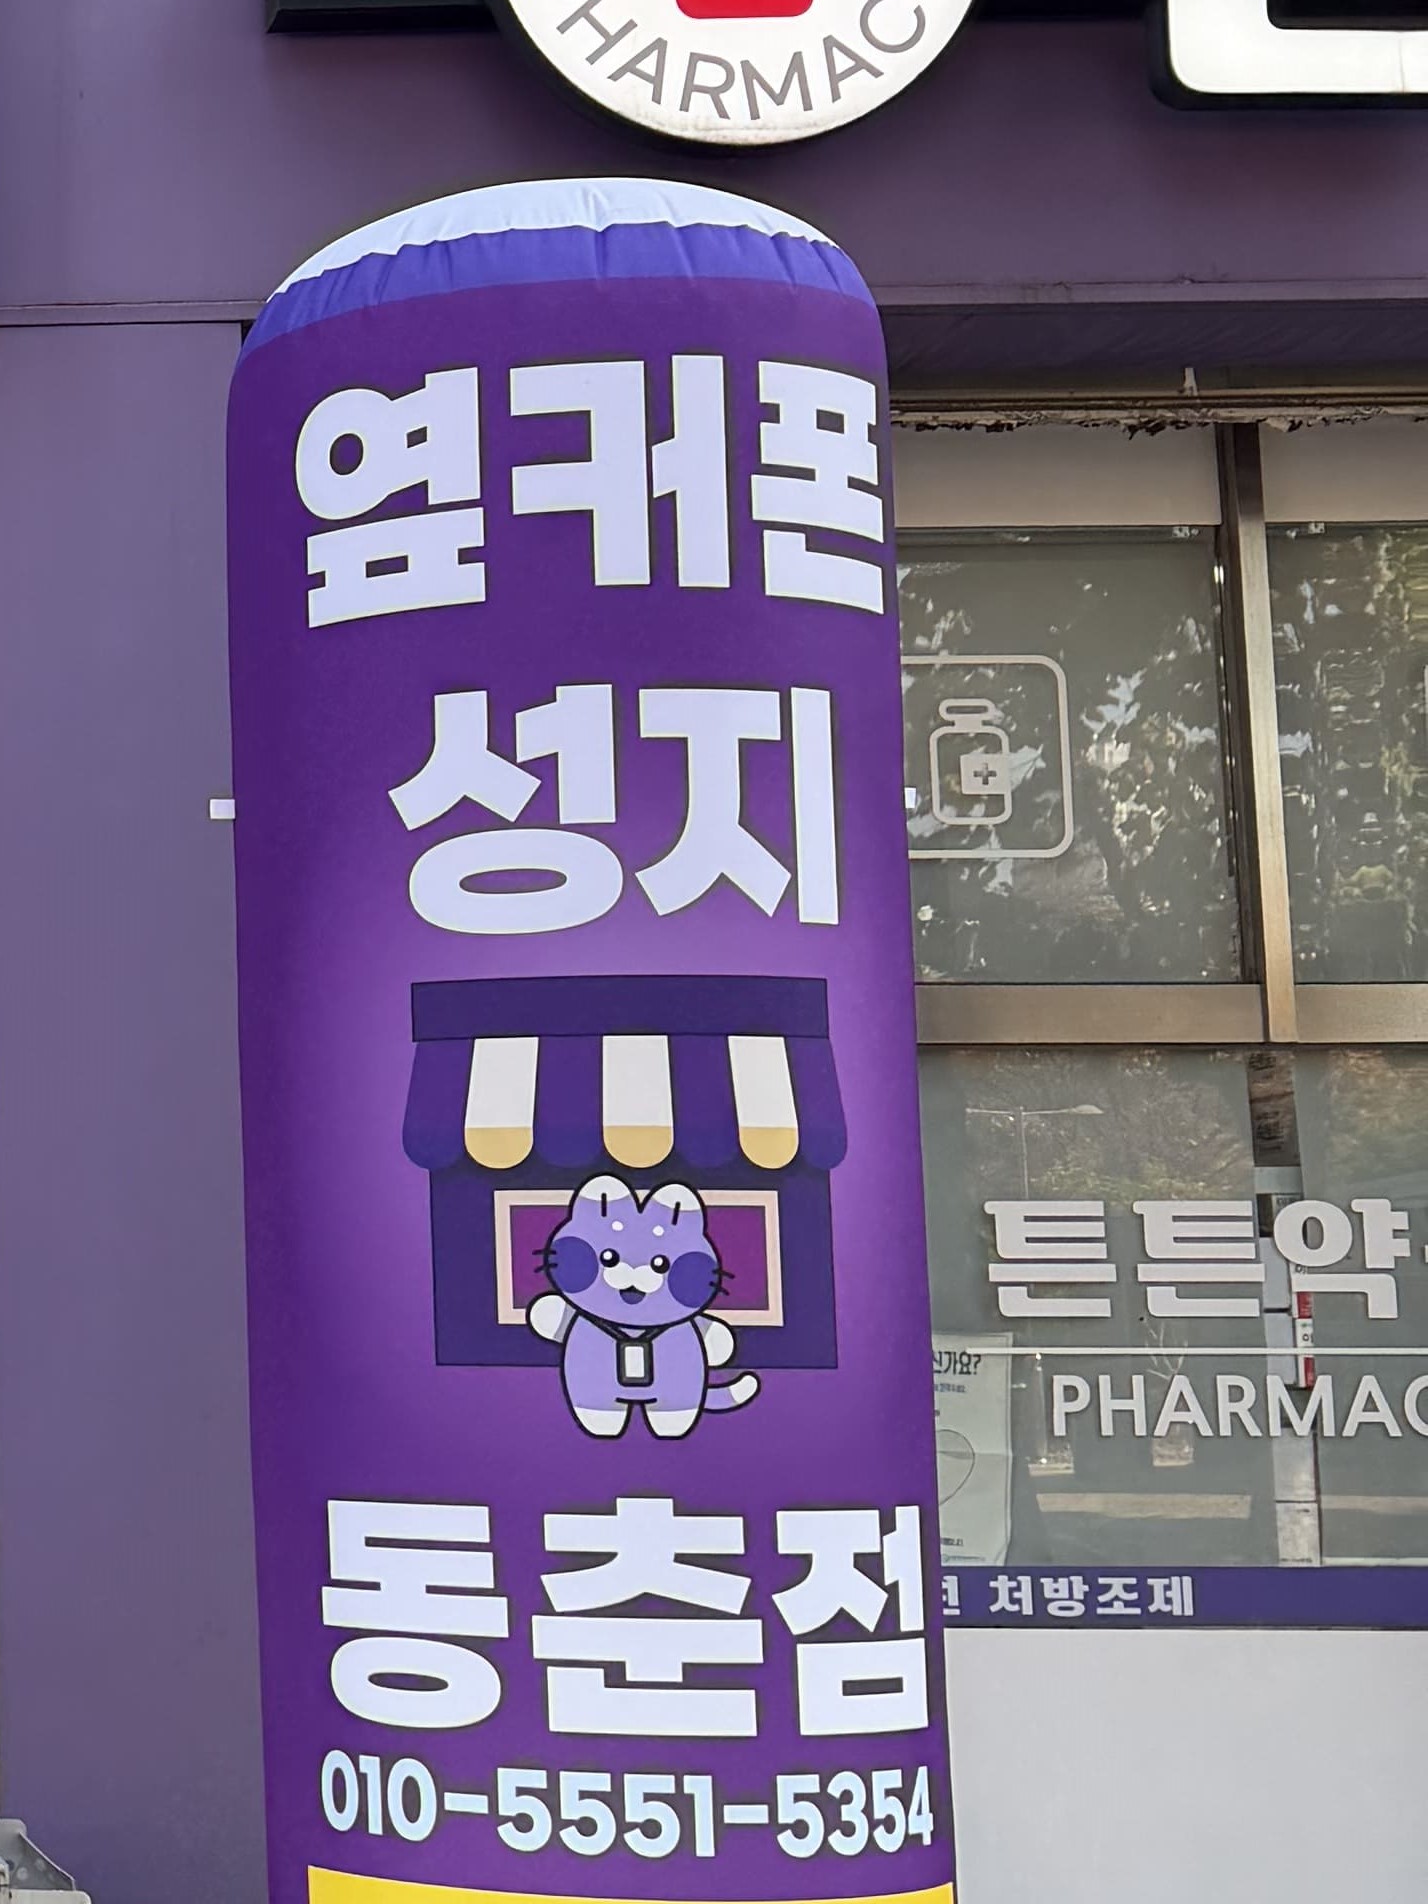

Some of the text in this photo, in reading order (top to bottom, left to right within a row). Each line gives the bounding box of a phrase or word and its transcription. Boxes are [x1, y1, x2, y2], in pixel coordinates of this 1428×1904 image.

[296, 354, 885, 628] 옆커폰
[388, 684, 839, 934] 성지
[984, 1199, 1428, 1318] 튼튼약
[320, 1497, 930, 1738] 동춘점
[989, 1575, 1194, 1617] 처방조제
[320, 1750, 933, 1857] 010-5551-5354
